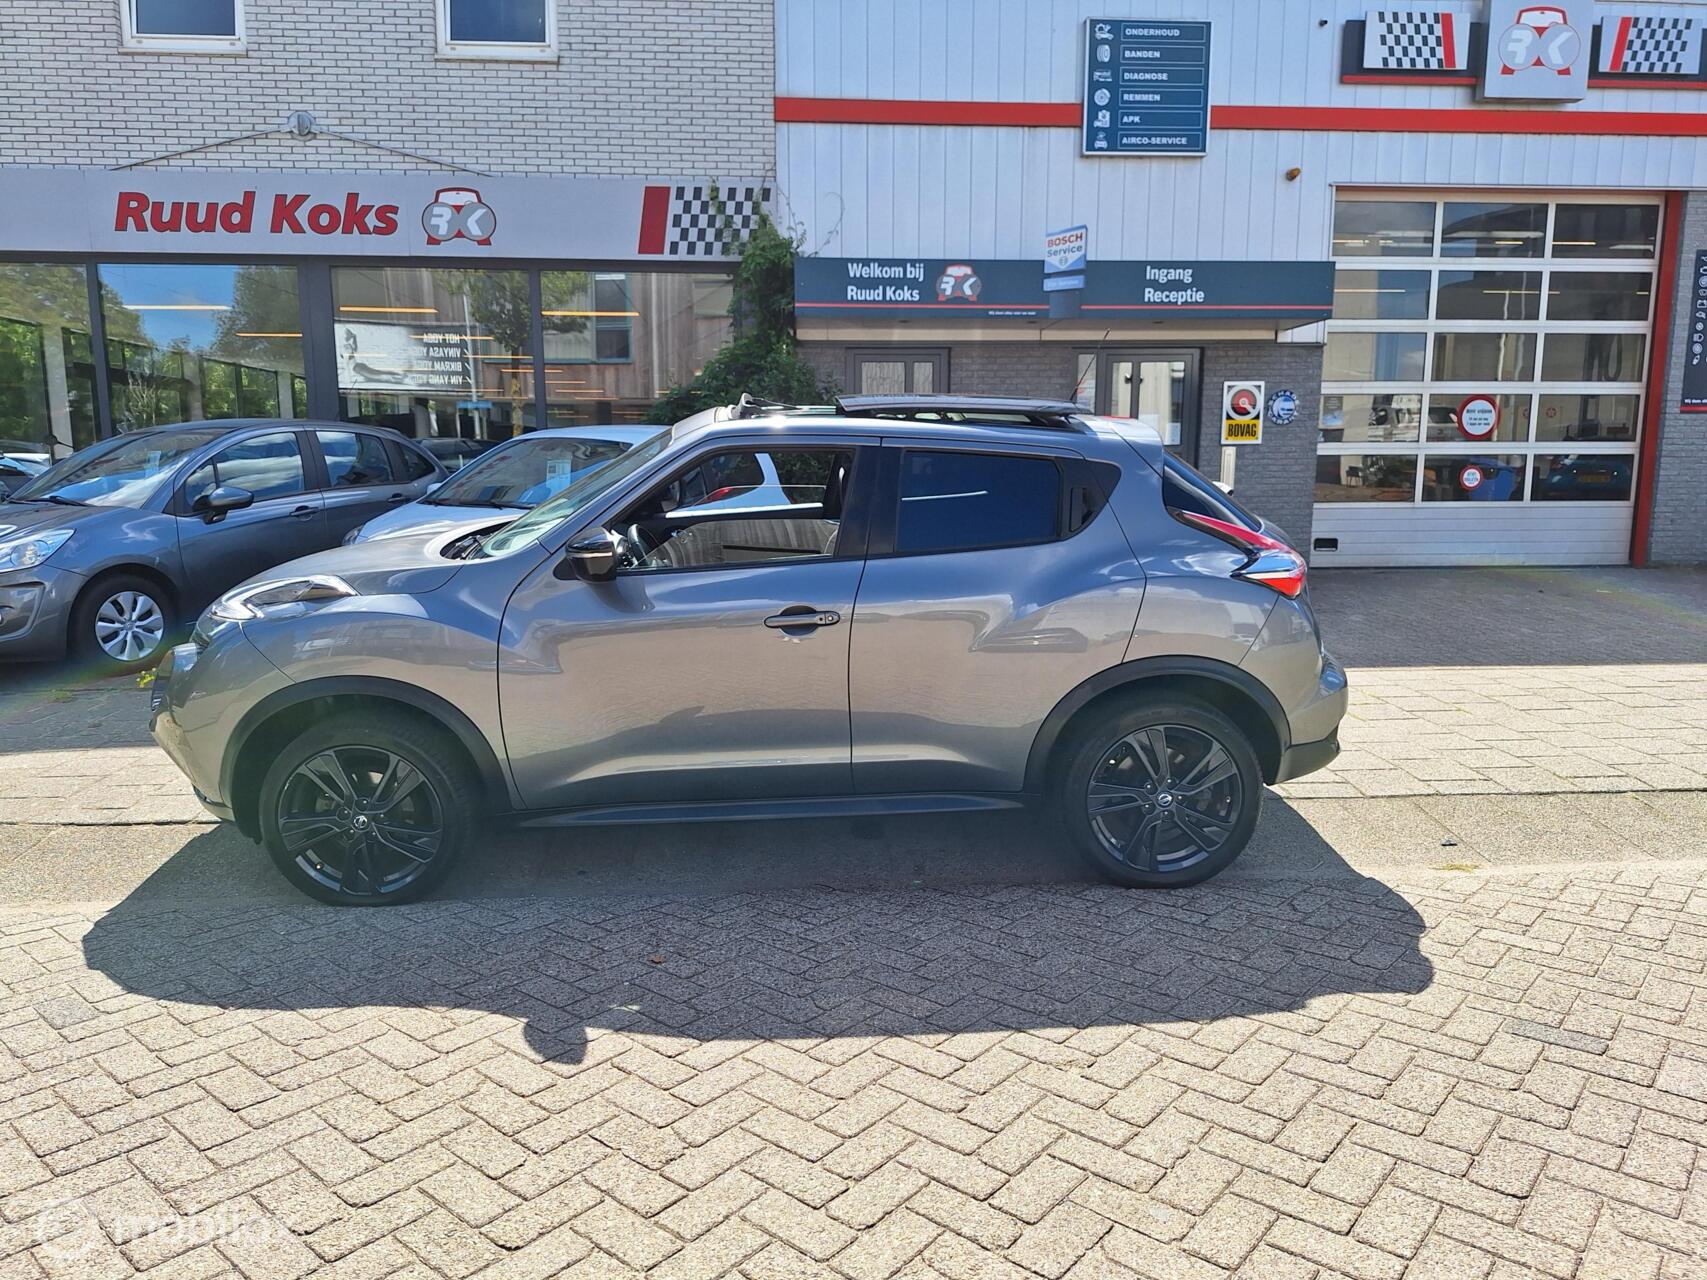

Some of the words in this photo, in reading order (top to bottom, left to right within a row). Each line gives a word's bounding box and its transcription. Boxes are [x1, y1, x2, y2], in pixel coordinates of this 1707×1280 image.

[1125, 28, 1180, 37] ONDERHOUD
[1124, 50, 1160, 58] BANDEN
[1123, 72, 1168, 81] DIAGNOSE
[1123, 93, 1160, 101] REMMEN
[1122, 115, 1140, 123] APK
[1122, 137, 1187, 145] AIRCO-SERVICE
[114, 191, 256, 233] Ruud
[269, 192, 400, 235] Koks
[1047, 231, 1083, 248] BOSCH
[1047, 244, 1083, 258] Service
[848, 262, 904, 279] Welkom
[906, 263, 924, 282] bij
[1146, 265, 1193, 283] Ingang
[847, 285, 883, 301] Ruud
[885, 285, 920, 301] Koks
[1144, 287, 1205, 305] Receptie
[1228, 423, 1257, 437] BOVAG
